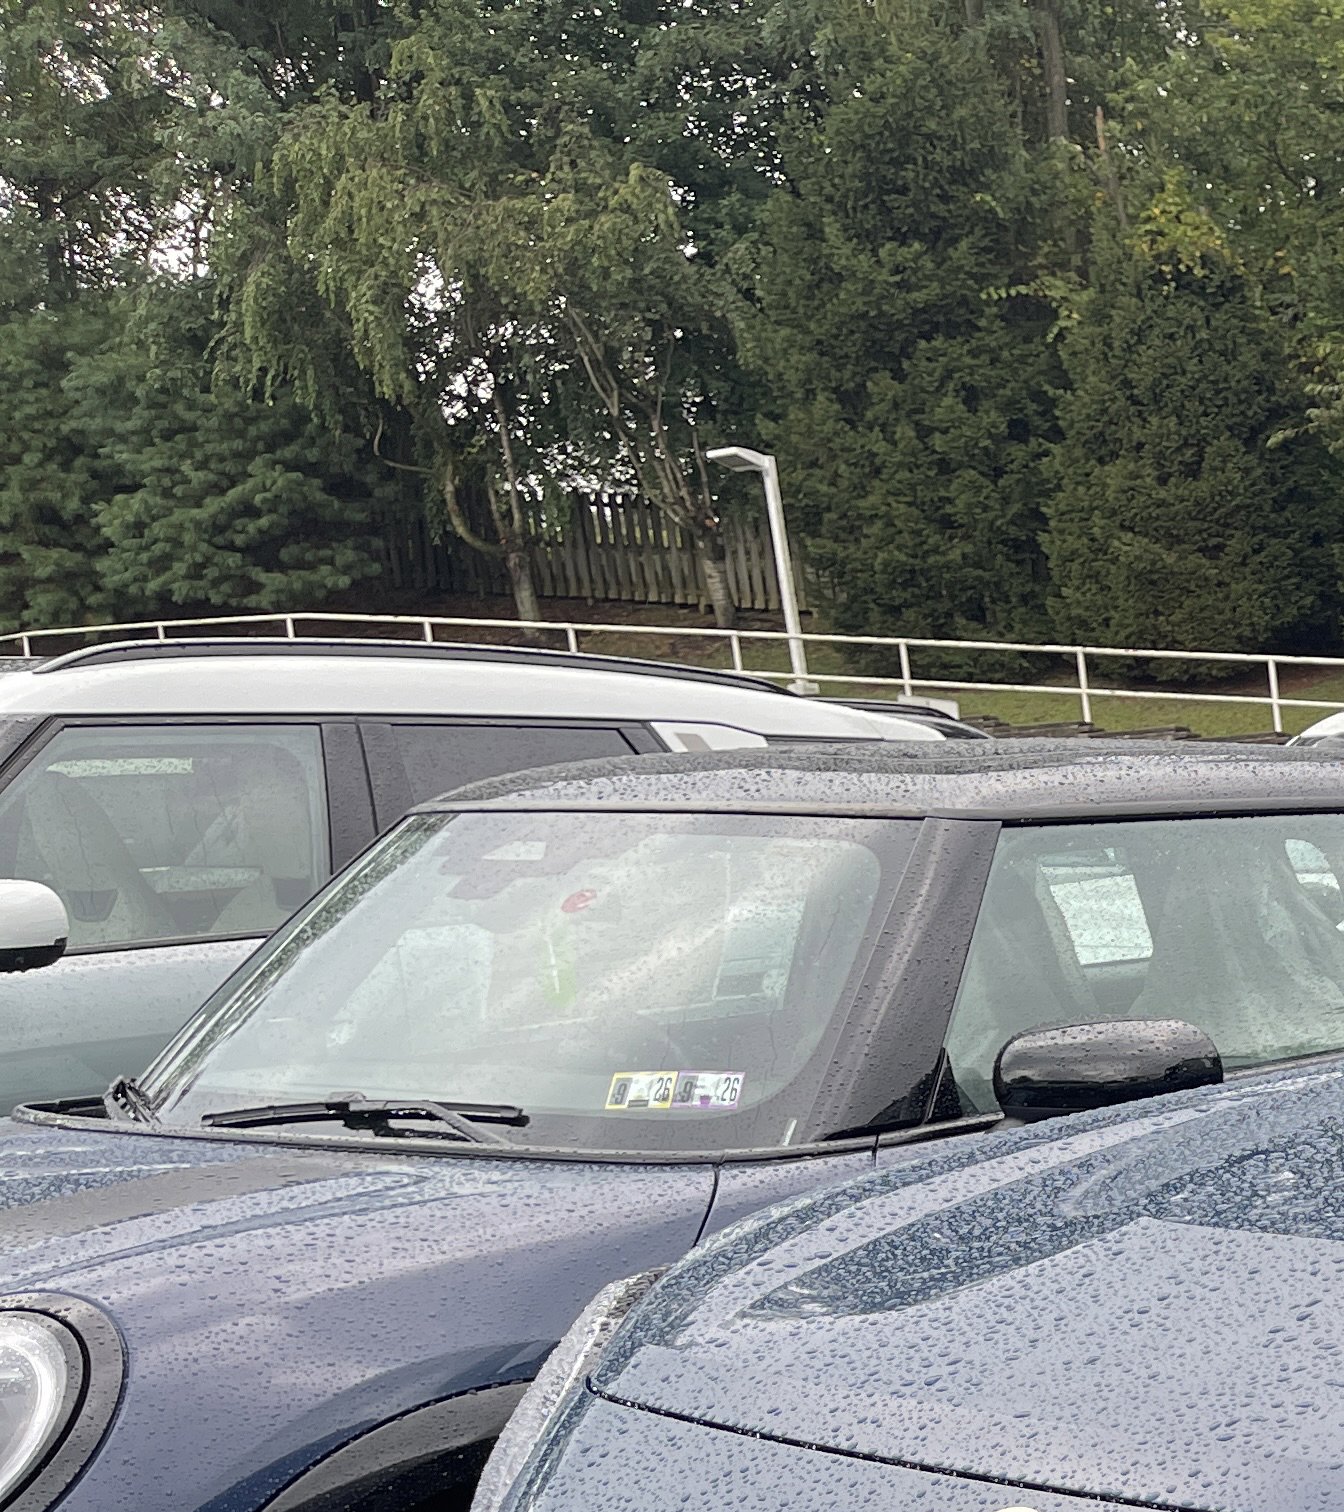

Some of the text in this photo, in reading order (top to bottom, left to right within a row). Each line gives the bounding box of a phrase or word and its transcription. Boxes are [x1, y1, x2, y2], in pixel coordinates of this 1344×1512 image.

[614, 1077, 673, 1105] 9 26
[681, 1077, 740, 1102] 9 26
